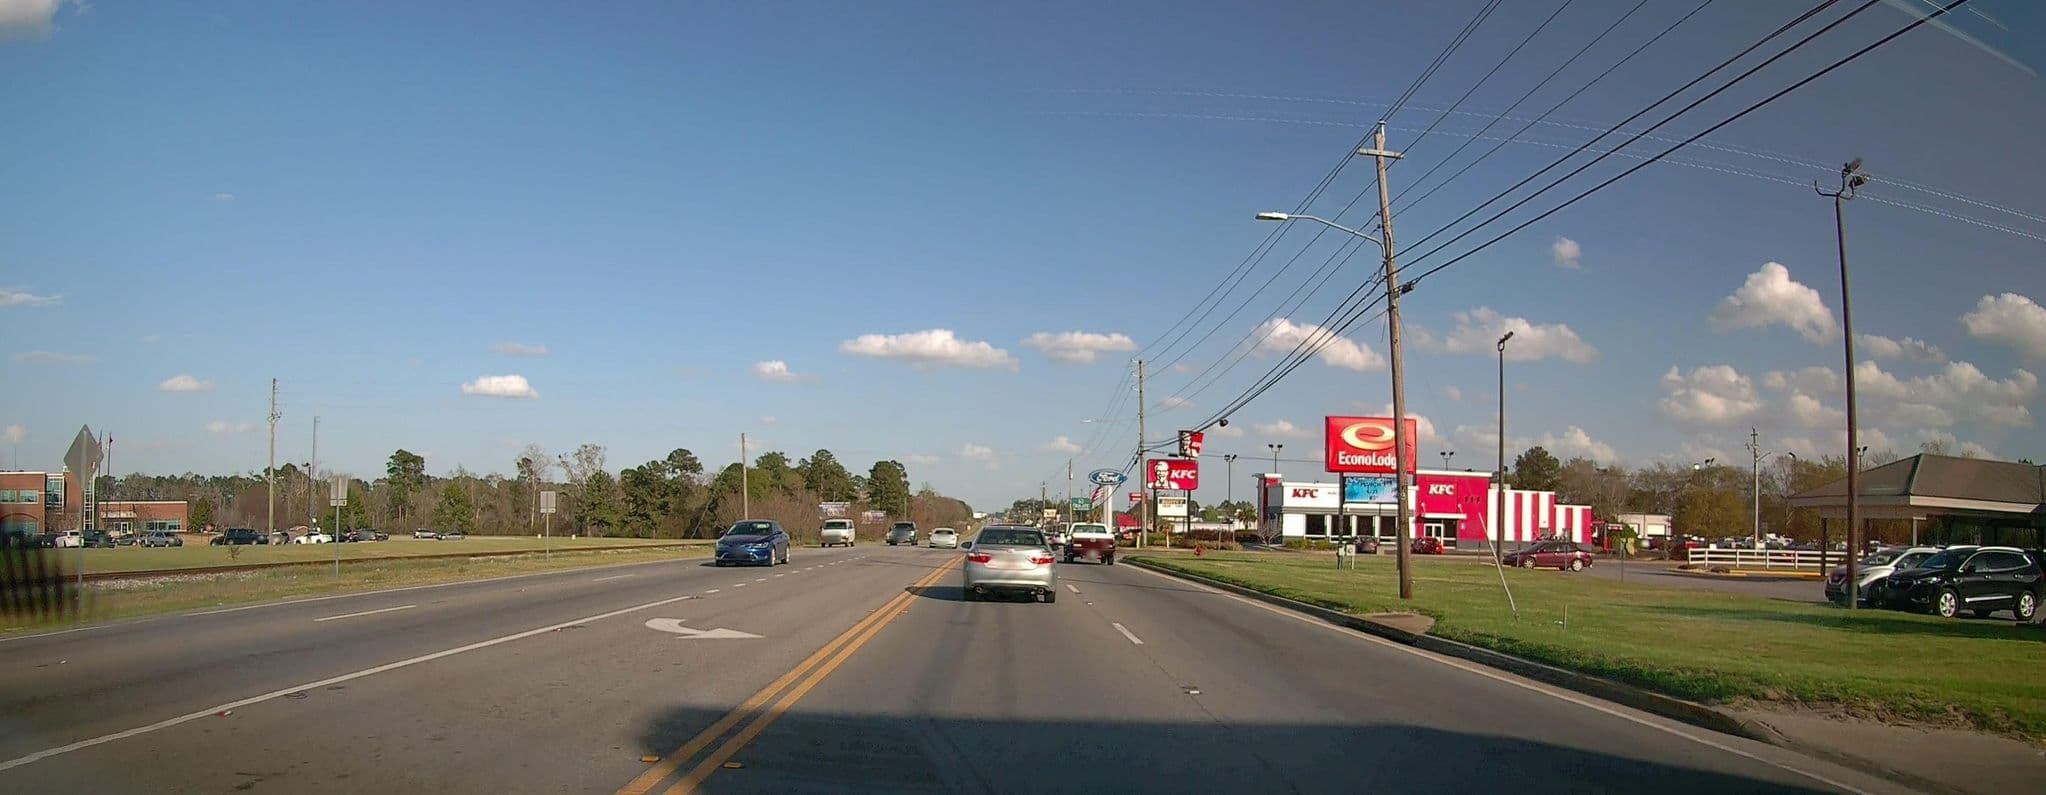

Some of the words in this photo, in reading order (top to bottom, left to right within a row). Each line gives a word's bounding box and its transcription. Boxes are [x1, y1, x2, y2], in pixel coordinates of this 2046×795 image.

[1338, 451, 1397, 470] EconoLodg
[1170, 469, 1196, 479] KFC
[1292, 488, 1318, 498] KFC
[1428, 484, 1454, 495] KFC
